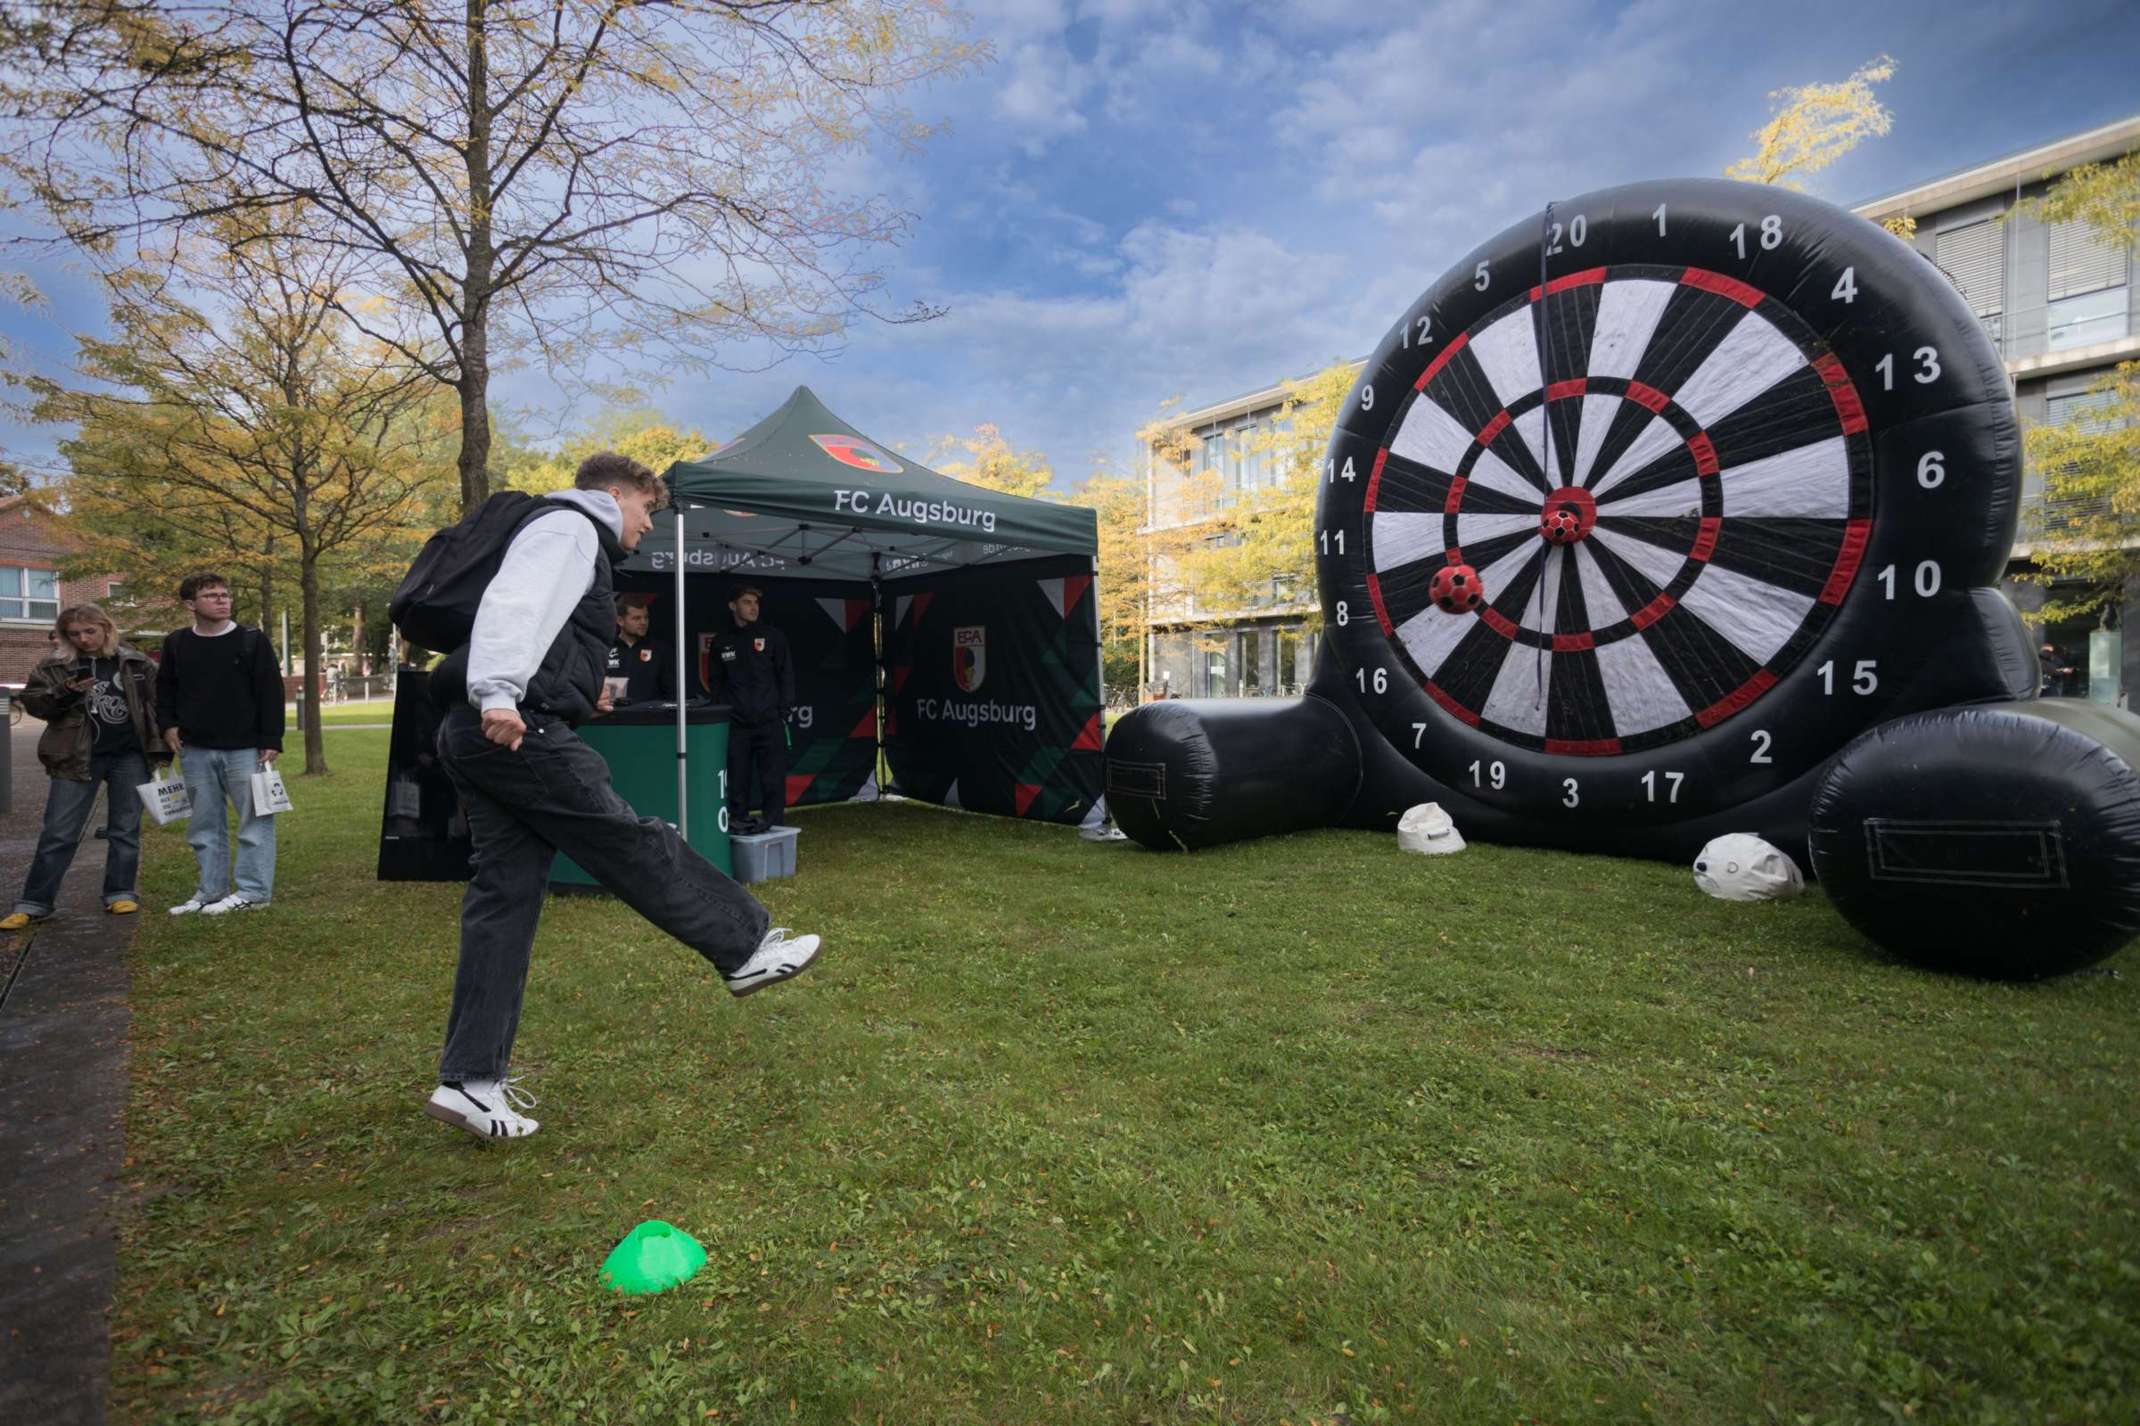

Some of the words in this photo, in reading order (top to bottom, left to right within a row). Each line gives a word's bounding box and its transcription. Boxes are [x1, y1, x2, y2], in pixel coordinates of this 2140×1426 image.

[1546, 214, 1588, 255] 20
[1652, 203, 1667, 237] 1
[1729, 214, 1783, 259] 18
[1474, 260, 1490, 291] 5
[1831, 267, 1857, 303] 4
[1399, 316, 1433, 349] 12
[1875, 346, 1941, 390] 13
[1360, 384, 1374, 411] 9
[1327, 456, 1356, 483] 14
[1917, 451, 1944, 489] 6
[833, 489, 870, 513] FC
[875, 492, 996, 533] Augsburg
[1320, 529, 1345, 555] 11
[1878, 561, 1941, 600] 10
[1336, 601, 1349, 627] 8
[1356, 667, 1387, 694] 16
[1817, 660, 1877, 695] 15
[916, 698, 937, 720] FC
[942, 699, 1037, 731] Augsburg
[1412, 722, 1427, 749] 7
[1750, 729, 1772, 763] 2
[1469, 760, 1506, 790] 19
[1642, 770, 1684, 803] 17
[1563, 777, 1579, 807] 3
